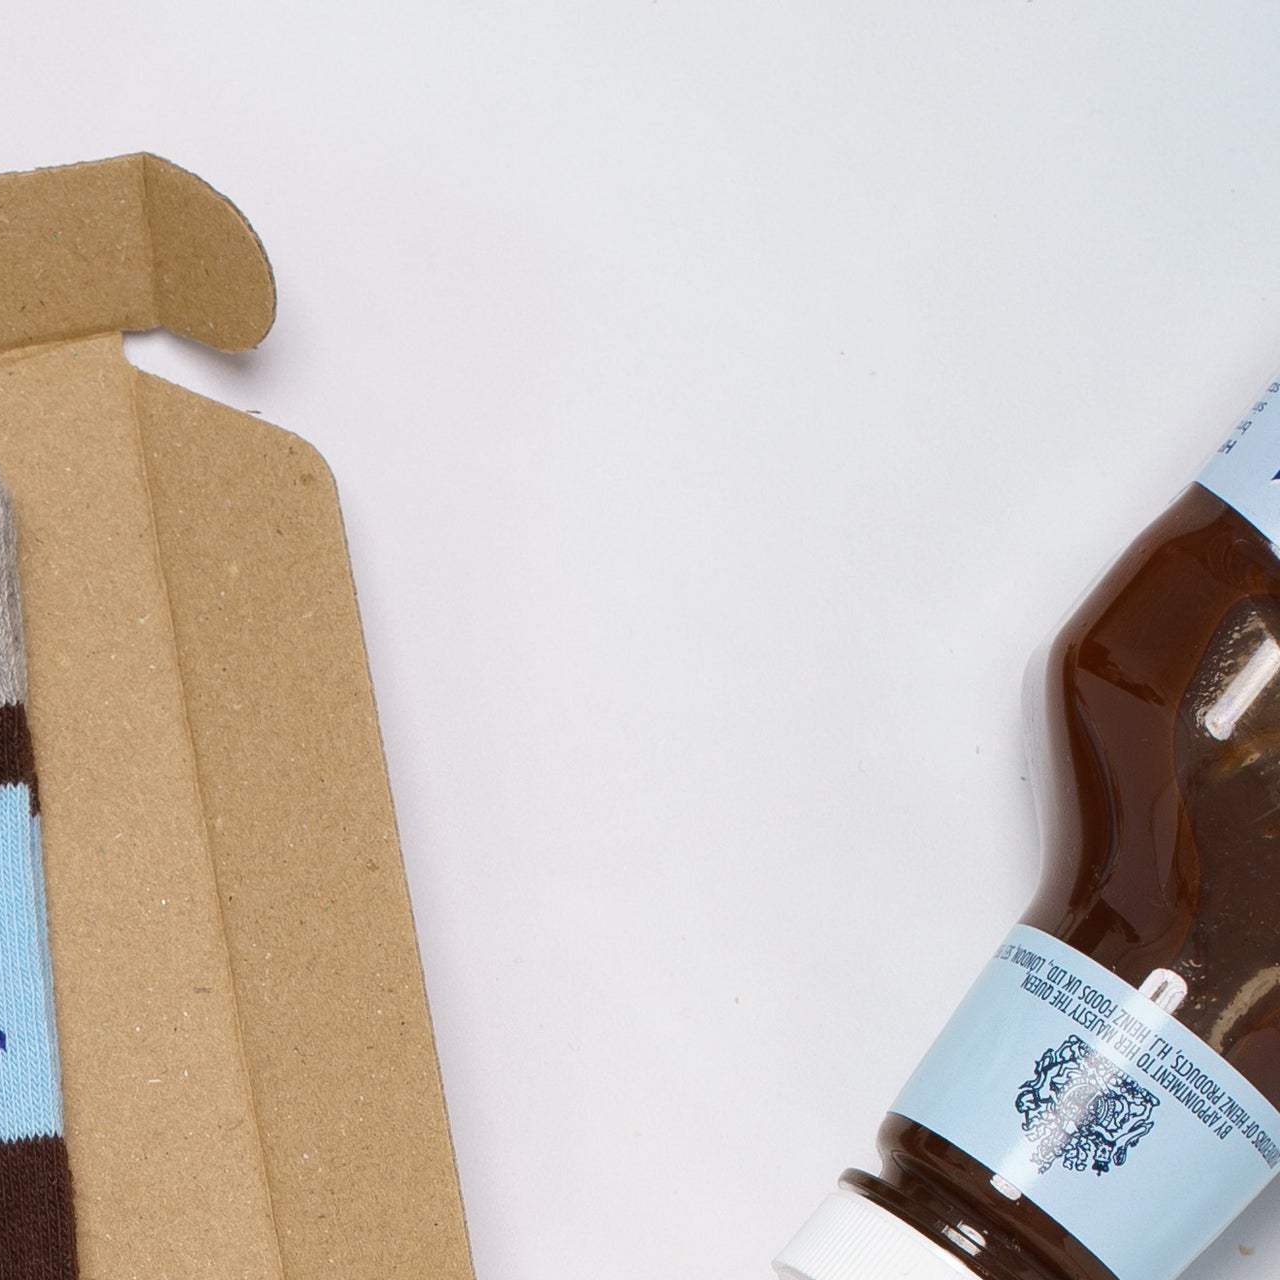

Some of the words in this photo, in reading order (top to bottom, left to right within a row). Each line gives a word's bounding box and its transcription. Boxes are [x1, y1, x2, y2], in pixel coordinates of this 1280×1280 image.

[1062, 974, 1083, 995] UK
[1049, 990, 1073, 1014] THE
[1078, 985, 1119, 1019] FOODS
[1068, 1003, 1119, 1044] MAJESTY
[1113, 1009, 1151, 1044] HEINZ
[1114, 1035, 1140, 1061] HER
[1136, 1053, 1155, 1074] TO
[1170, 1049, 1226, 1104] PRODUCTS,
[1150, 1065, 1223, 1129] APPOINTMENT
[1218, 1096, 1251, 1129] HEINZ
[1213, 1121, 1233, 1140] BY
[1241, 1121, 1259, 1139] OF
